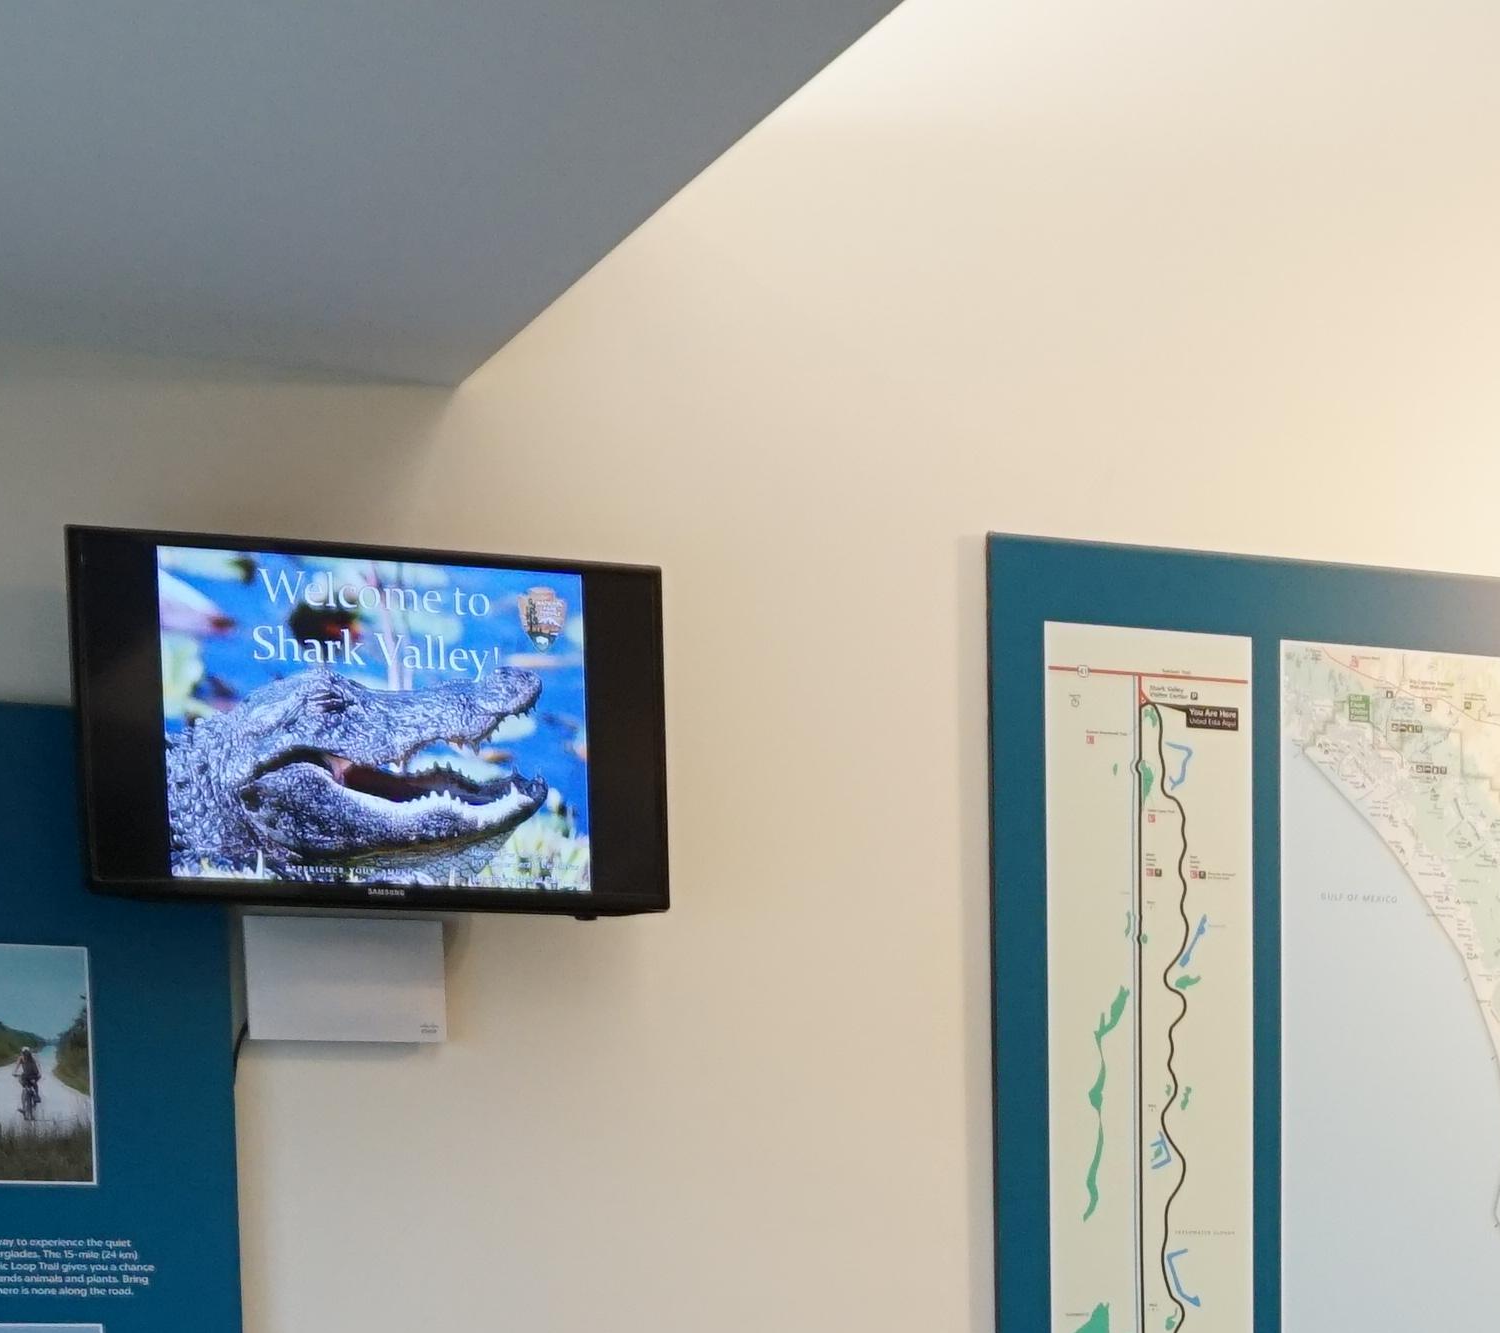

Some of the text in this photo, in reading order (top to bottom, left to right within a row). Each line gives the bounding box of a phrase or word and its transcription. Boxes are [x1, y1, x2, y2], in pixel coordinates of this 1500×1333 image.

[259, 568, 490, 617] Welcome to
[252, 625, 499, 683] Shark Valley!
